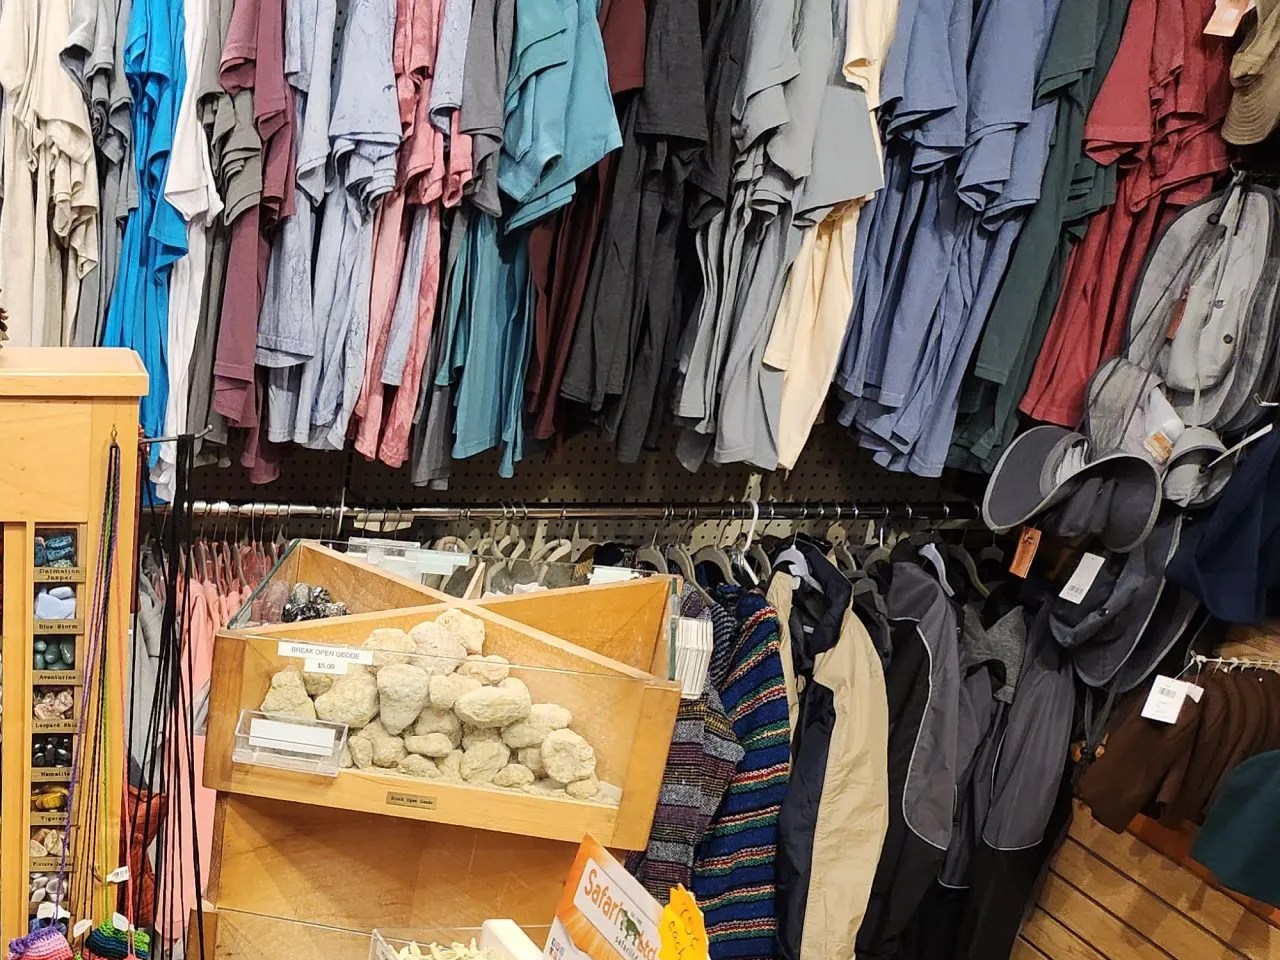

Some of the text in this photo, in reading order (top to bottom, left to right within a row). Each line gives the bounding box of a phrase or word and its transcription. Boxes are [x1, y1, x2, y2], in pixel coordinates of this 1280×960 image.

[291, 646, 361, 660] BREAK OPEN GEODE
[317, 662, 336, 670] $5.00
[584, 868, 624, 926] Safari
